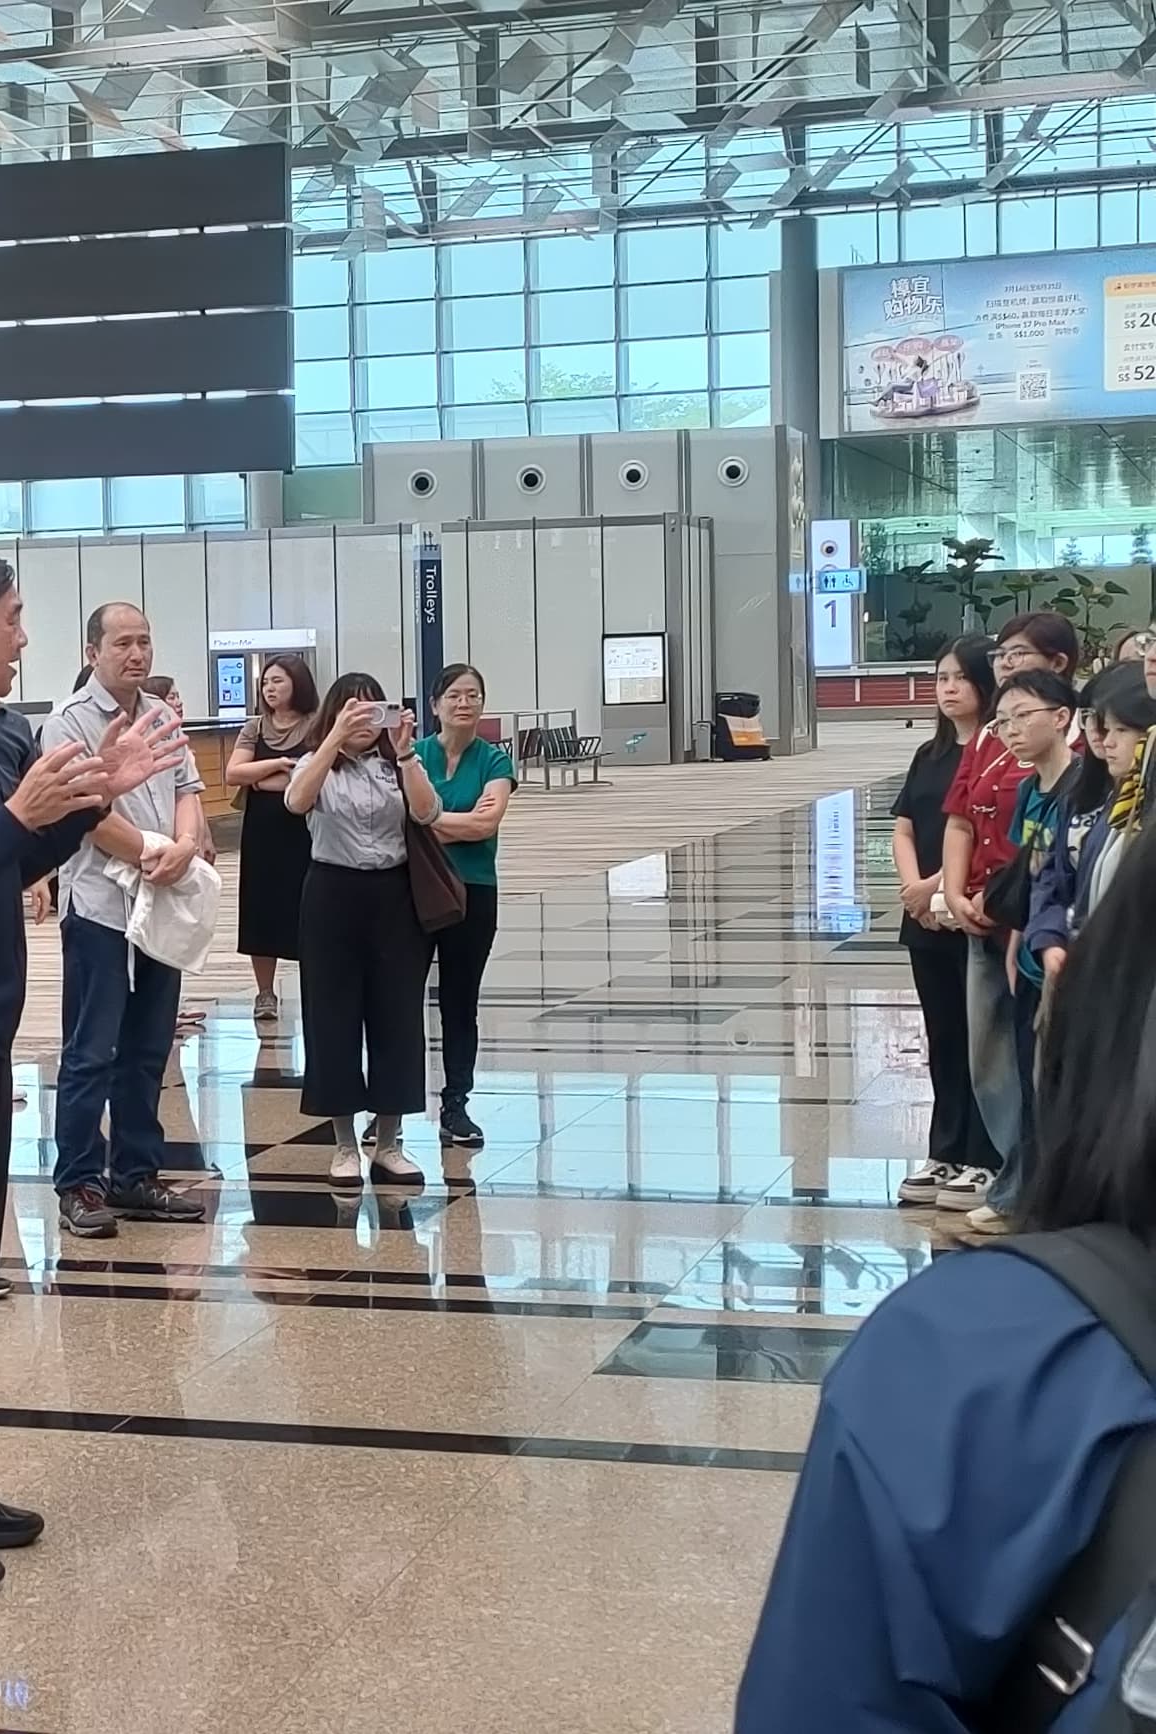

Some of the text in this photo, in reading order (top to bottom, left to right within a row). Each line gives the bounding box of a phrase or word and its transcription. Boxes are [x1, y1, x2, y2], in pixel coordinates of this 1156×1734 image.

[890, 275, 930, 298] 樟宜
[883, 295, 943, 320] 购物乐
[995, 322, 1021, 330] iPhone
[1034, 319, 1048, 329] Pro
[1048, 318, 1066, 326] Max
[424, 565, 438, 624] Trolleys
[824, 600, 836, 628] 1
